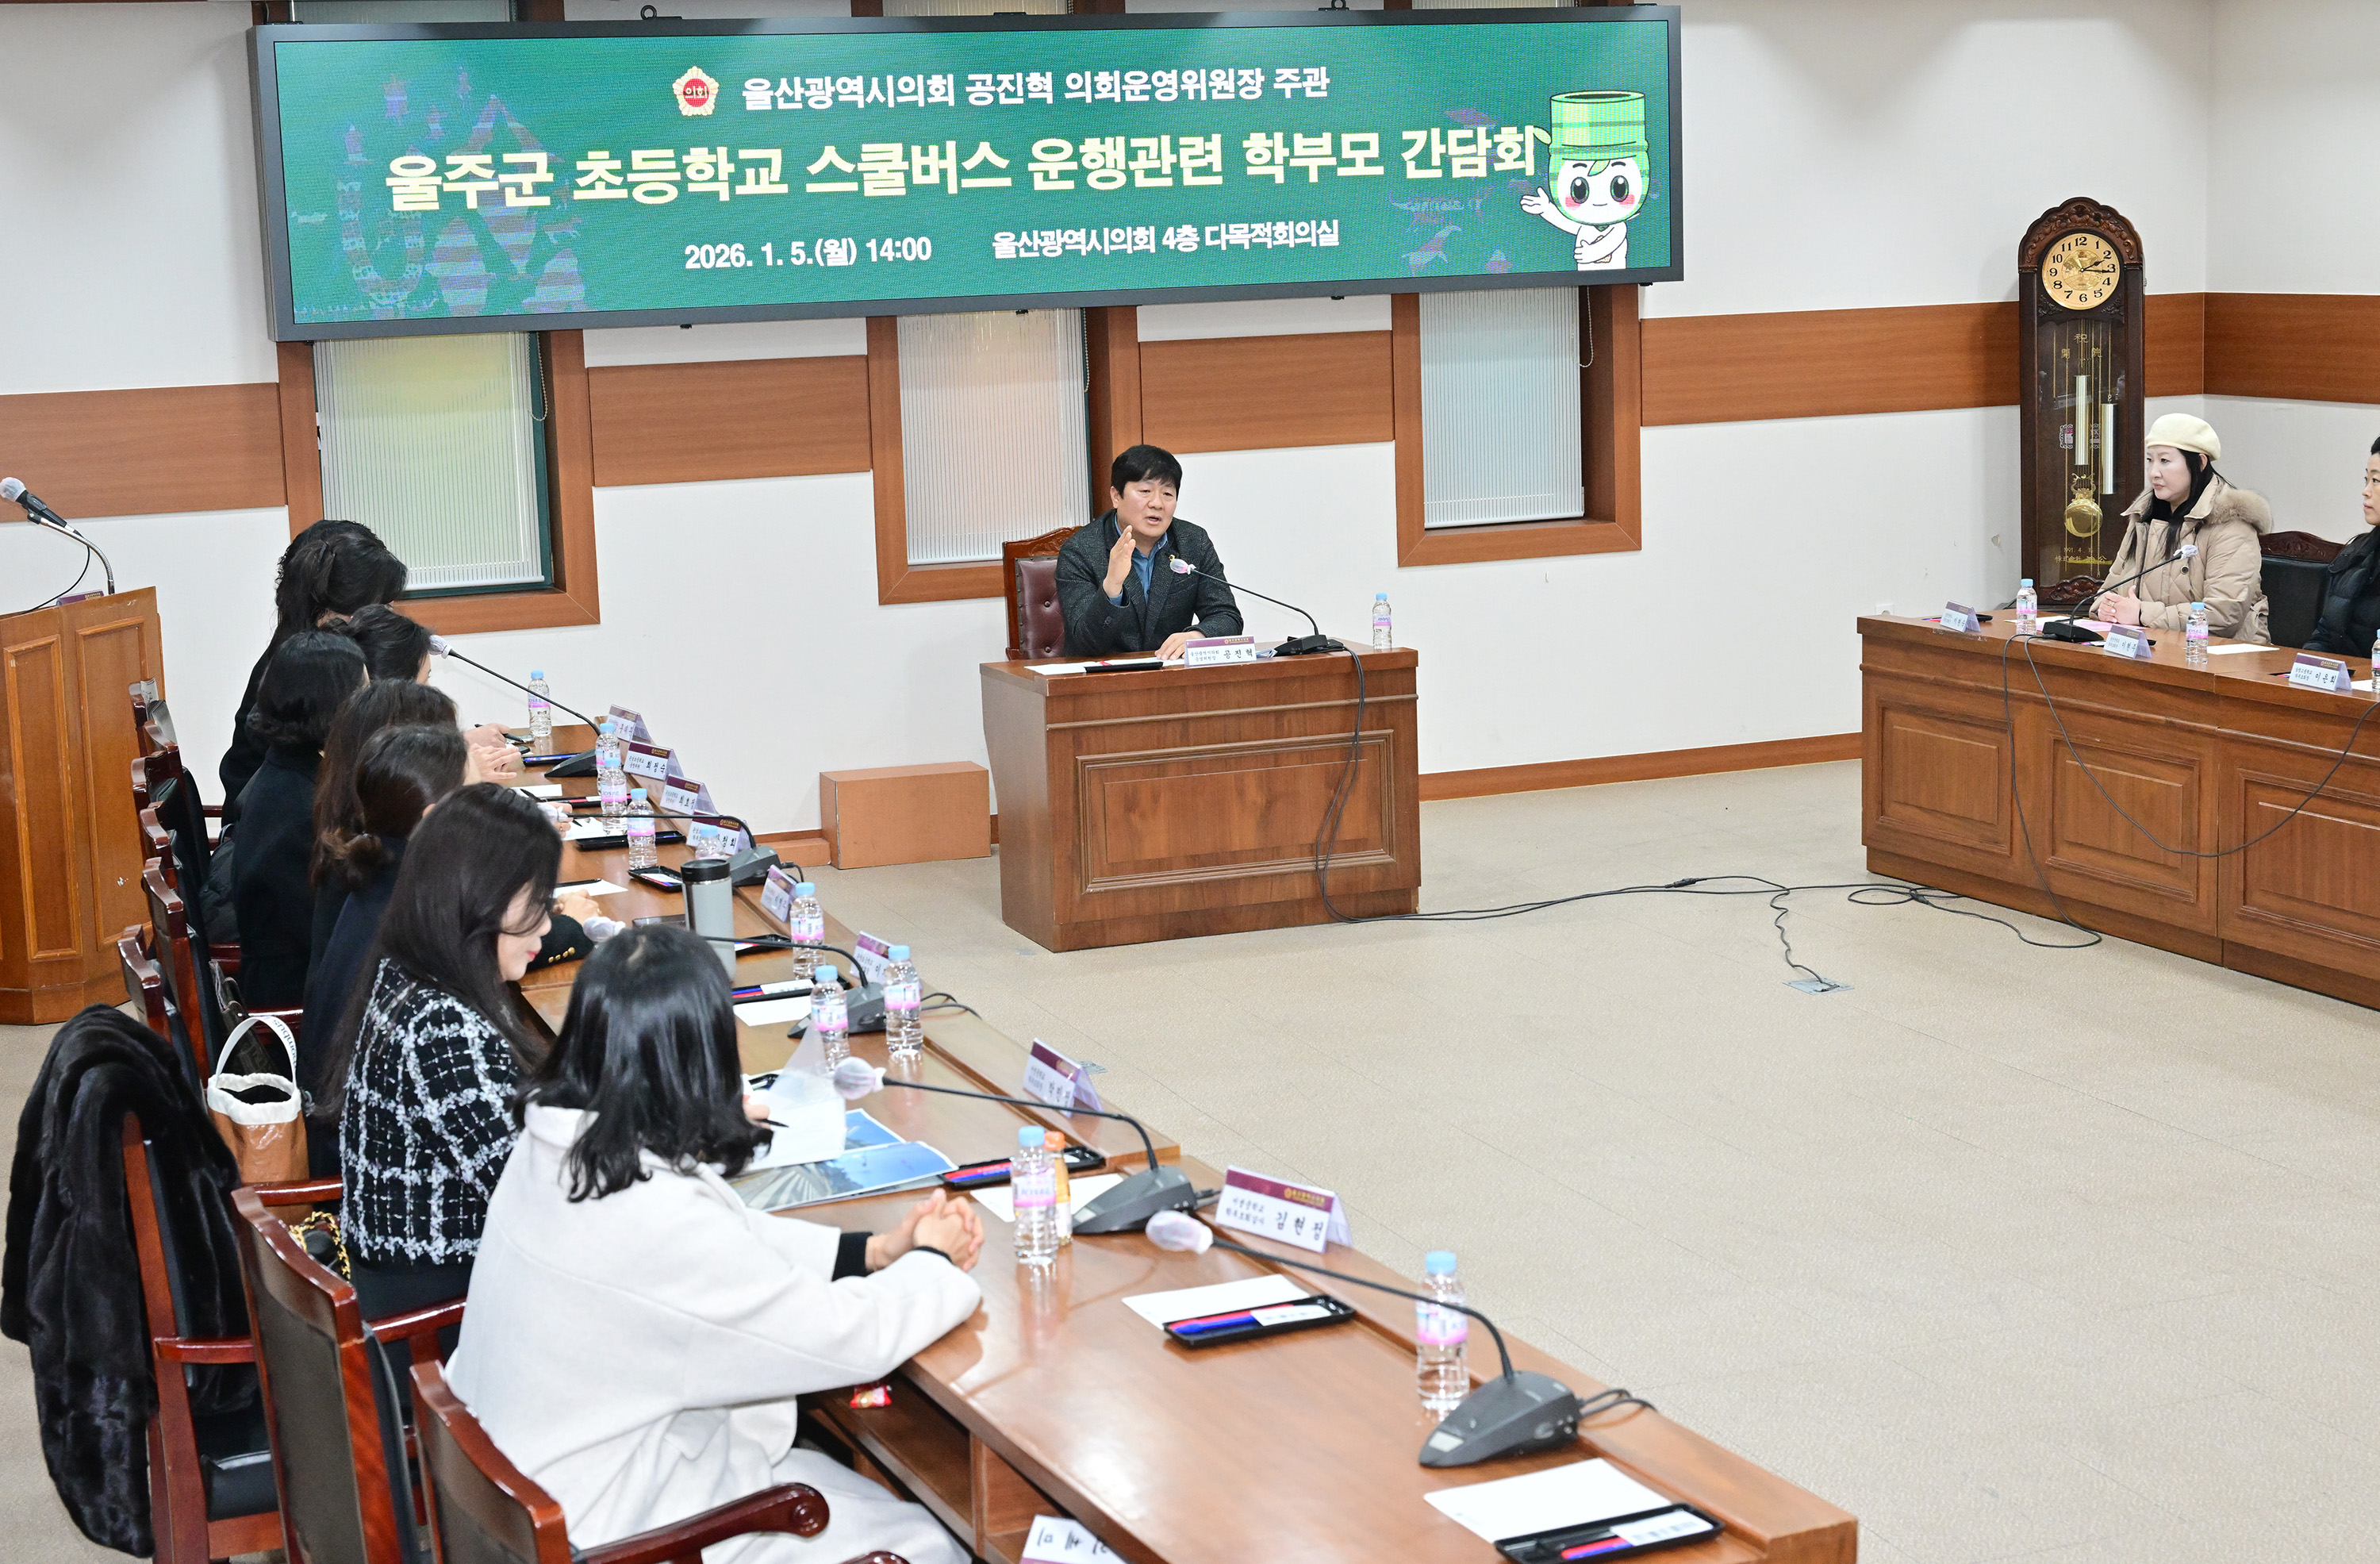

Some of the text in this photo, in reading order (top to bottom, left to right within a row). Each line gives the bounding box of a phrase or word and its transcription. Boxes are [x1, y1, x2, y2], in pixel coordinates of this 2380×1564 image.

[685, 86, 708, 98] 의회
[743, 67, 1330, 110] 울산광역시의회 공진혁 의회운영위원장 주관
[386, 125, 1534, 211] 울주군 초등학교 스쿨버스 운행관련 학부모 간담회
[992, 220, 1339, 259] 울산광역시의회 4층 다목적회의실
[2075, 236, 2087, 246] 12
[2095, 240, 2099, 249] 1
[2062, 242, 2071, 252] 11
[685, 244, 753, 269] 2026.
[866, 236, 932, 262] 14:00
[2103, 251, 2111, 259] 2
[2052, 254, 2063, 263] 10
[2107, 264, 2116, 273] 3
[2079, 294, 2087, 302] 6
[2094, 289, 2102, 298] 5
